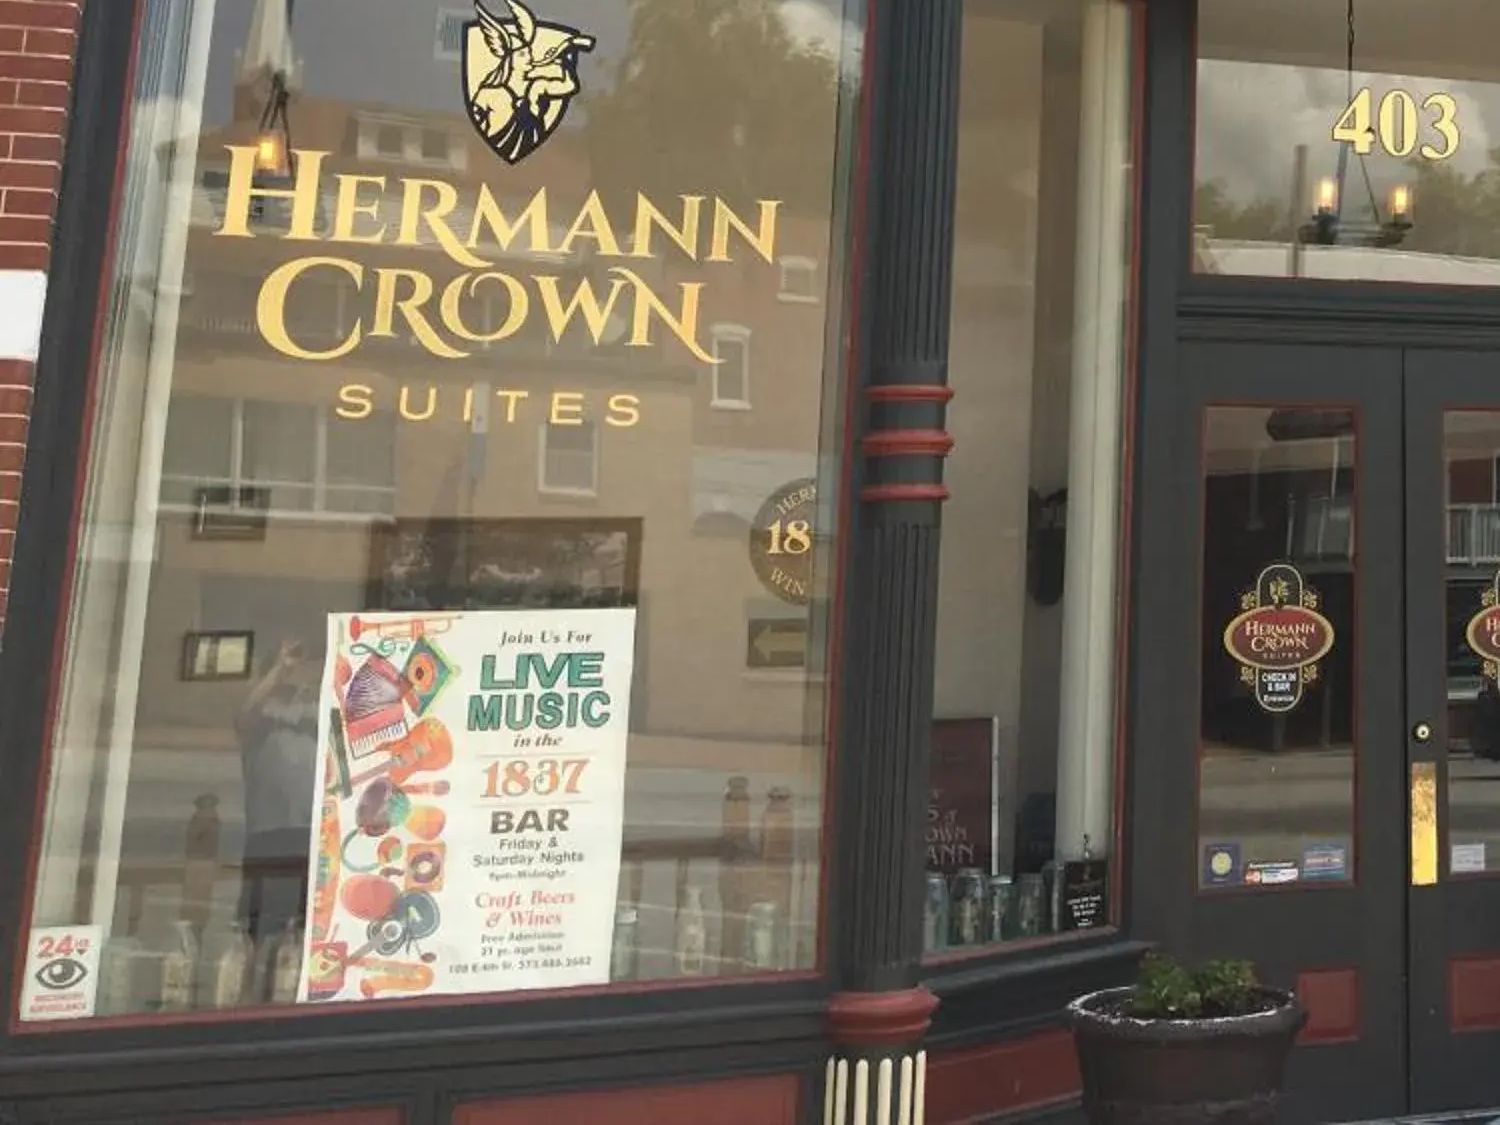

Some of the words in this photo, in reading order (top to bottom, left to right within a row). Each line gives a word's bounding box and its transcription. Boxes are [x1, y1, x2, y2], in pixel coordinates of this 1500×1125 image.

[1332, 86, 1461, 160] 403
[213, 145, 783, 268] HERMANN
[256, 256, 727, 364] CROWN
[336, 386, 641, 427] SUITES
[500, 631, 533, 647] Join
[541, 630, 561, 643] Us
[567, 630, 592, 643] For
[1245, 621, 1315, 637] HERMANN
[1251, 636, 1309, 652] CROWN
[480, 652, 605, 690] LIVE
[467, 690, 611, 731] MUSIC
[513, 734, 531, 747] in
[535, 733, 563, 747] the
[480, 758, 591, 798] 1837
[490, 809, 570, 834] BAR
[499, 838, 541, 851] Friday
[547, 836, 558, 848] &
[473, 854, 534, 868] Saturday
[541, 851, 584, 865] Nights
[475, 891, 522, 908] Craft
[531, 890, 575, 905] Beers
[485, 912, 502, 928] &
[510, 910, 562, 926] Wines
[37, 934, 75, 958] 24
